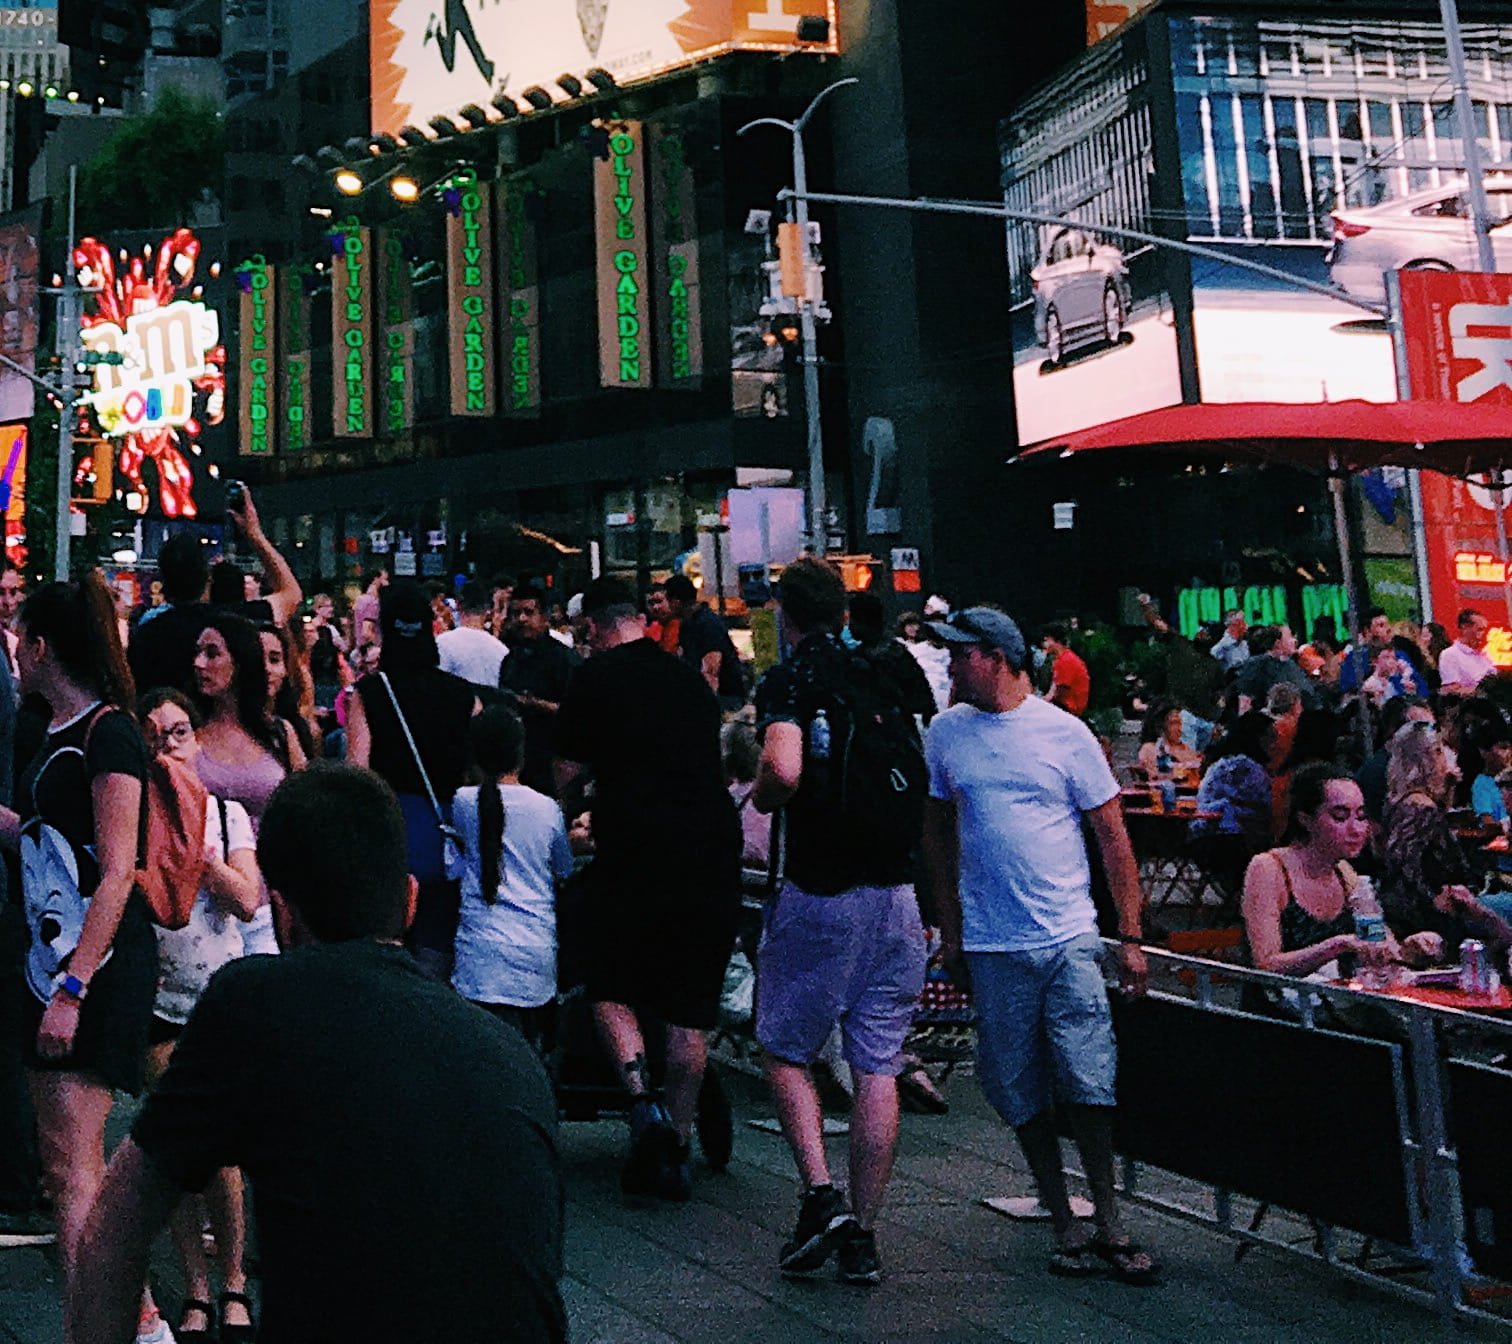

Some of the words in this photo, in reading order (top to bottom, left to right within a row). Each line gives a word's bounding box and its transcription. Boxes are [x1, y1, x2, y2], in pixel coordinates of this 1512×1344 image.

[610, 133, 635, 239] OLIVE
[344, 236, 363, 323] OLIVE
[462, 191, 482, 286] OLIVE
[250, 272, 269, 351] OLIVE
[462, 295, 486, 412] GARDEN
[614, 250, 640, 382] GARDEN
[249, 357, 268, 452] GARDEN
[344, 328, 364, 433] GARDEN
